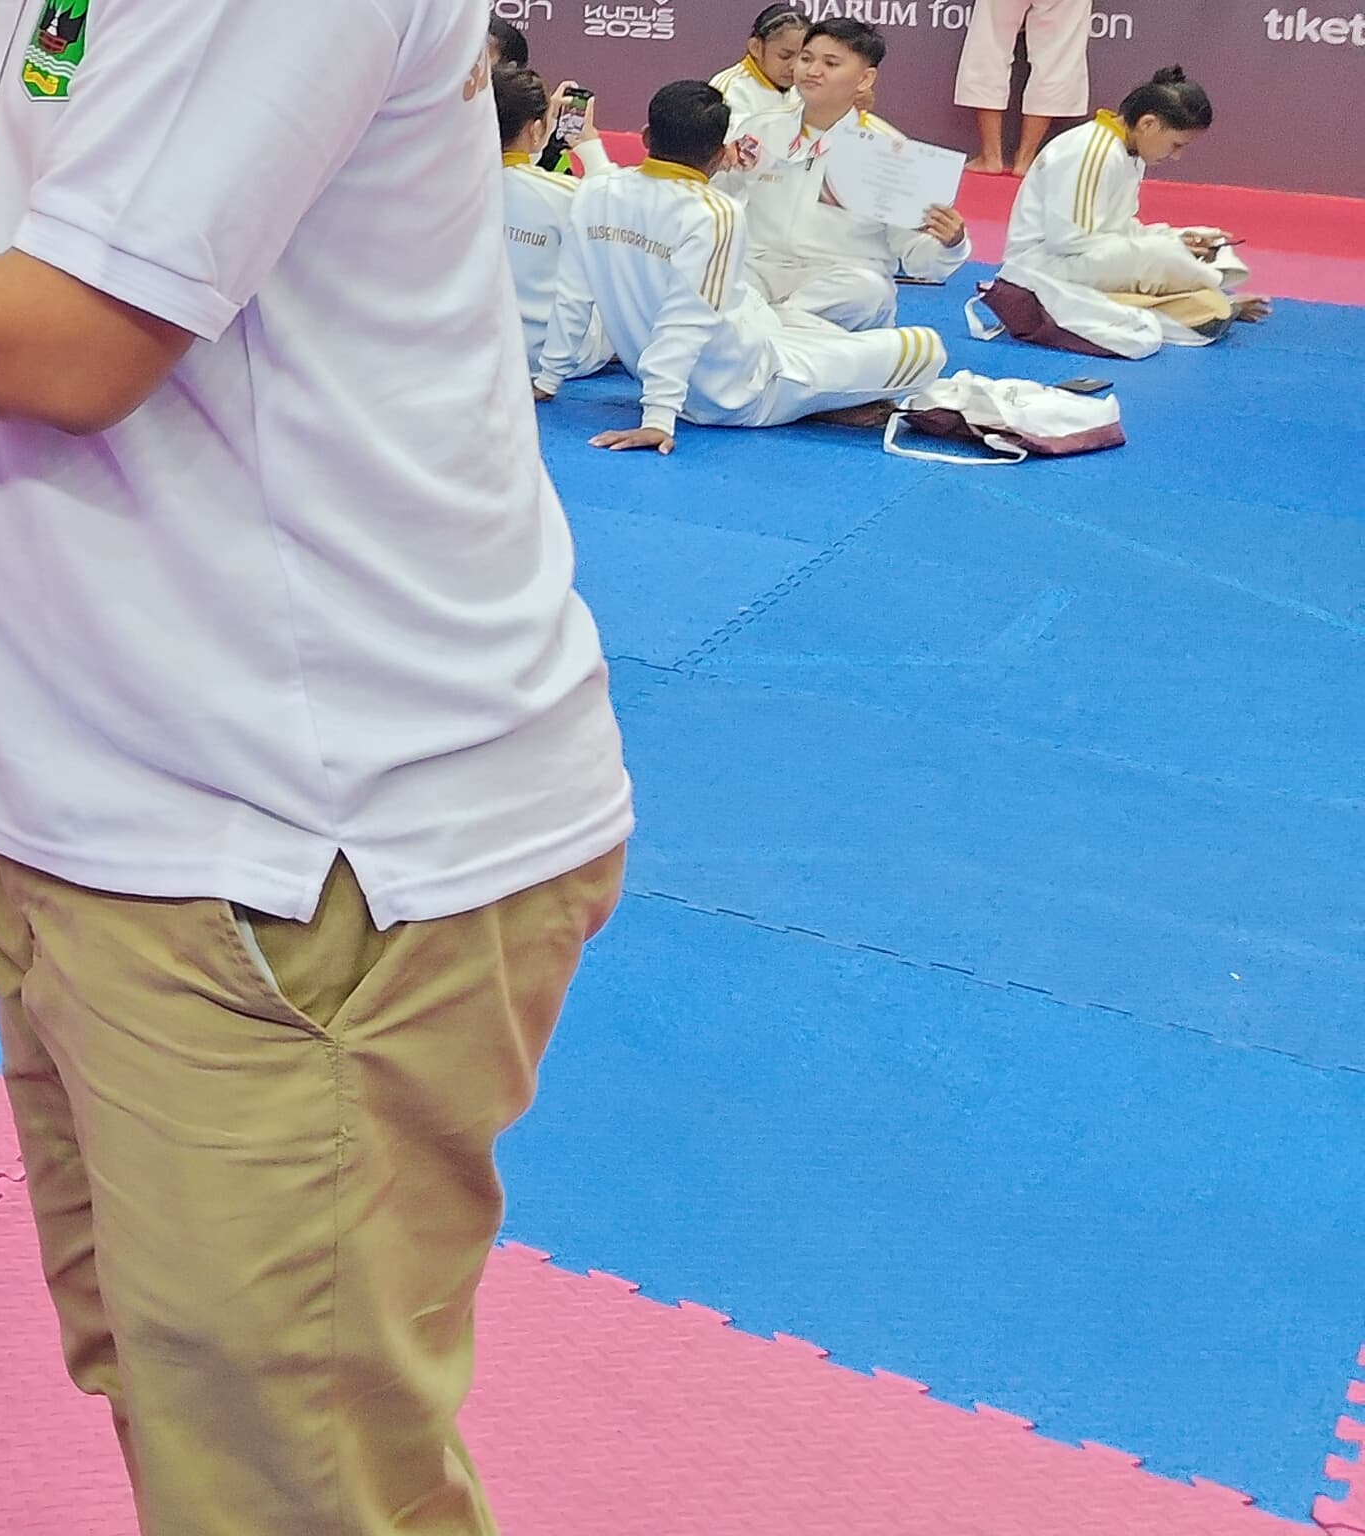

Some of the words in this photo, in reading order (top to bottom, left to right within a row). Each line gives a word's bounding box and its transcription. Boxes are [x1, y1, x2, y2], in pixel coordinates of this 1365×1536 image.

[584, 4, 674, 23] KUDUS
[584, 19, 675, 40] 2025
[509, 226, 547, 247] TIMUR
